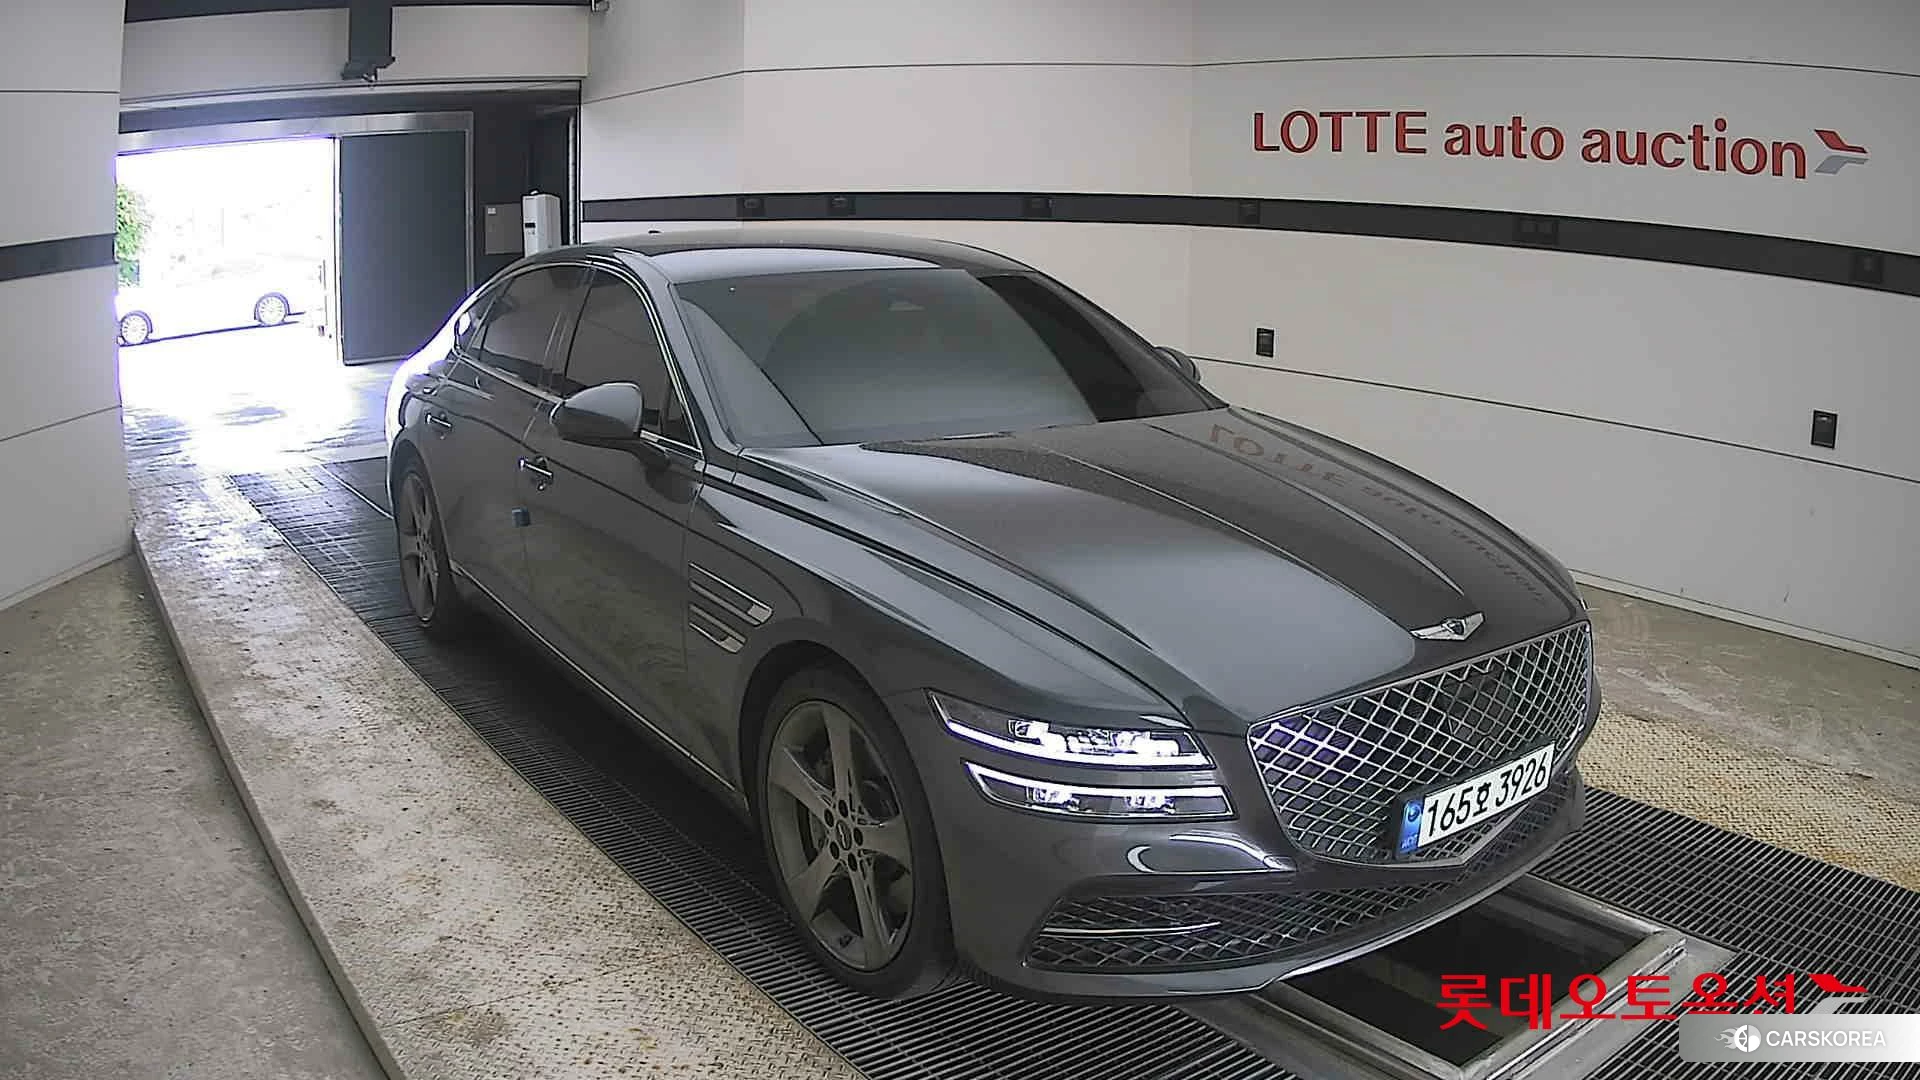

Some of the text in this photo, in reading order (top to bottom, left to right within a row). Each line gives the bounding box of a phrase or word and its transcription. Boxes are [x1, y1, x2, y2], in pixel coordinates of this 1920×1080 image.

[1253, 110, 1807, 180] LOTTE auto auction
[1427, 751, 1548, 837] 165호 3926
